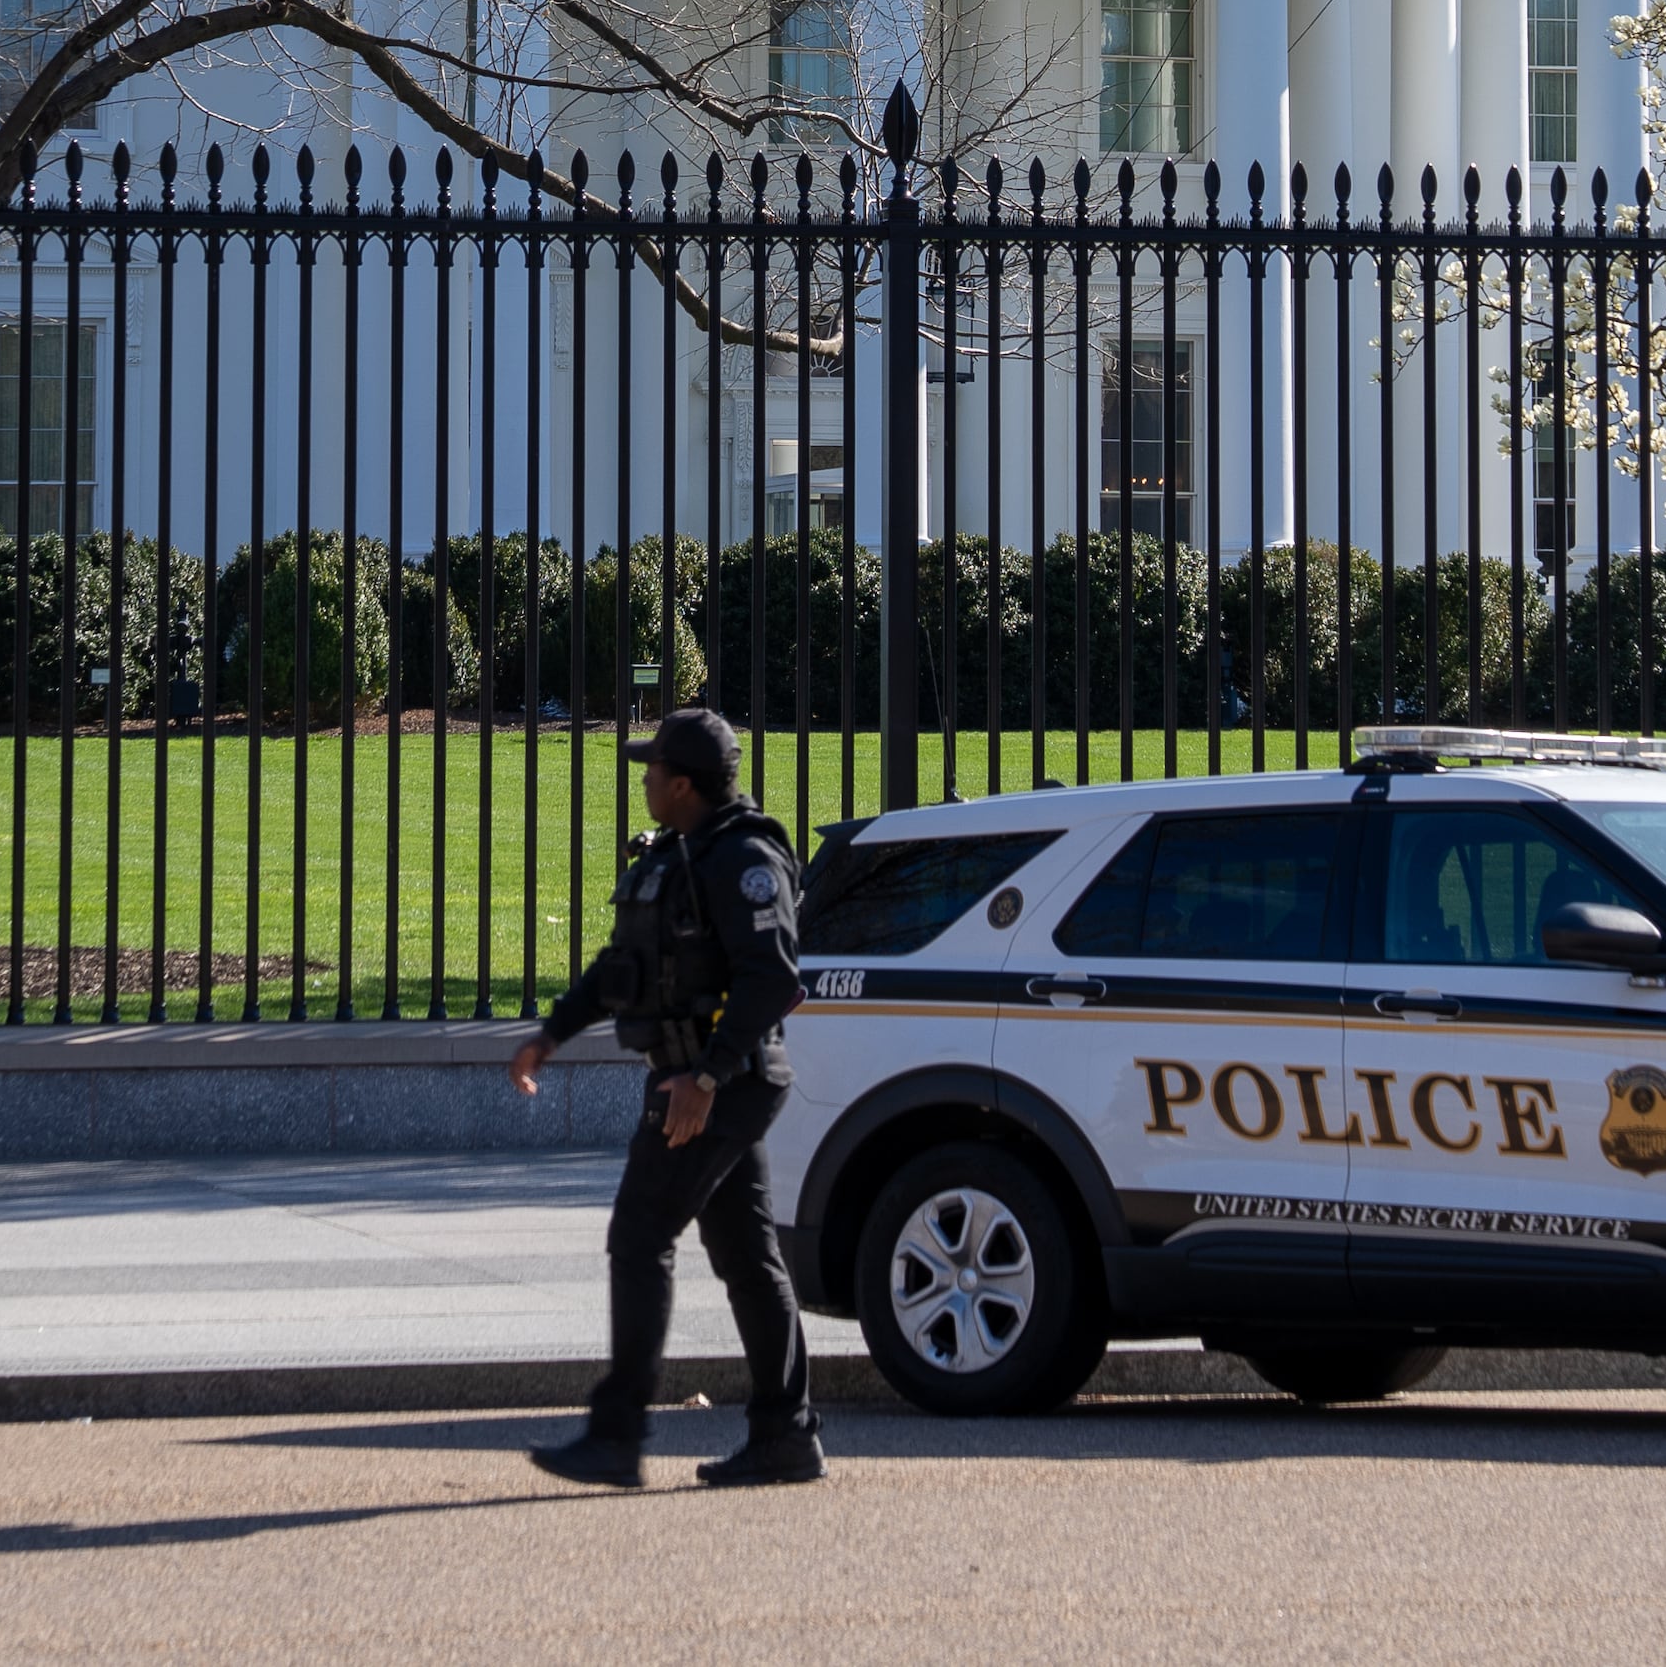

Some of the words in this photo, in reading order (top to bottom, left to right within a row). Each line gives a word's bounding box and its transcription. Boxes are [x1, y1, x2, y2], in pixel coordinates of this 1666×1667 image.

[815, 969, 866, 998] 4138
[1134, 1057, 1568, 1160] POLICE
[1193, 1194, 1292, 1218] UNITED
[1295, 1200, 1392, 1224] STATES
[1397, 1206, 1506, 1231] SECRET
[1510, 1213, 1632, 1240] SERVICE
